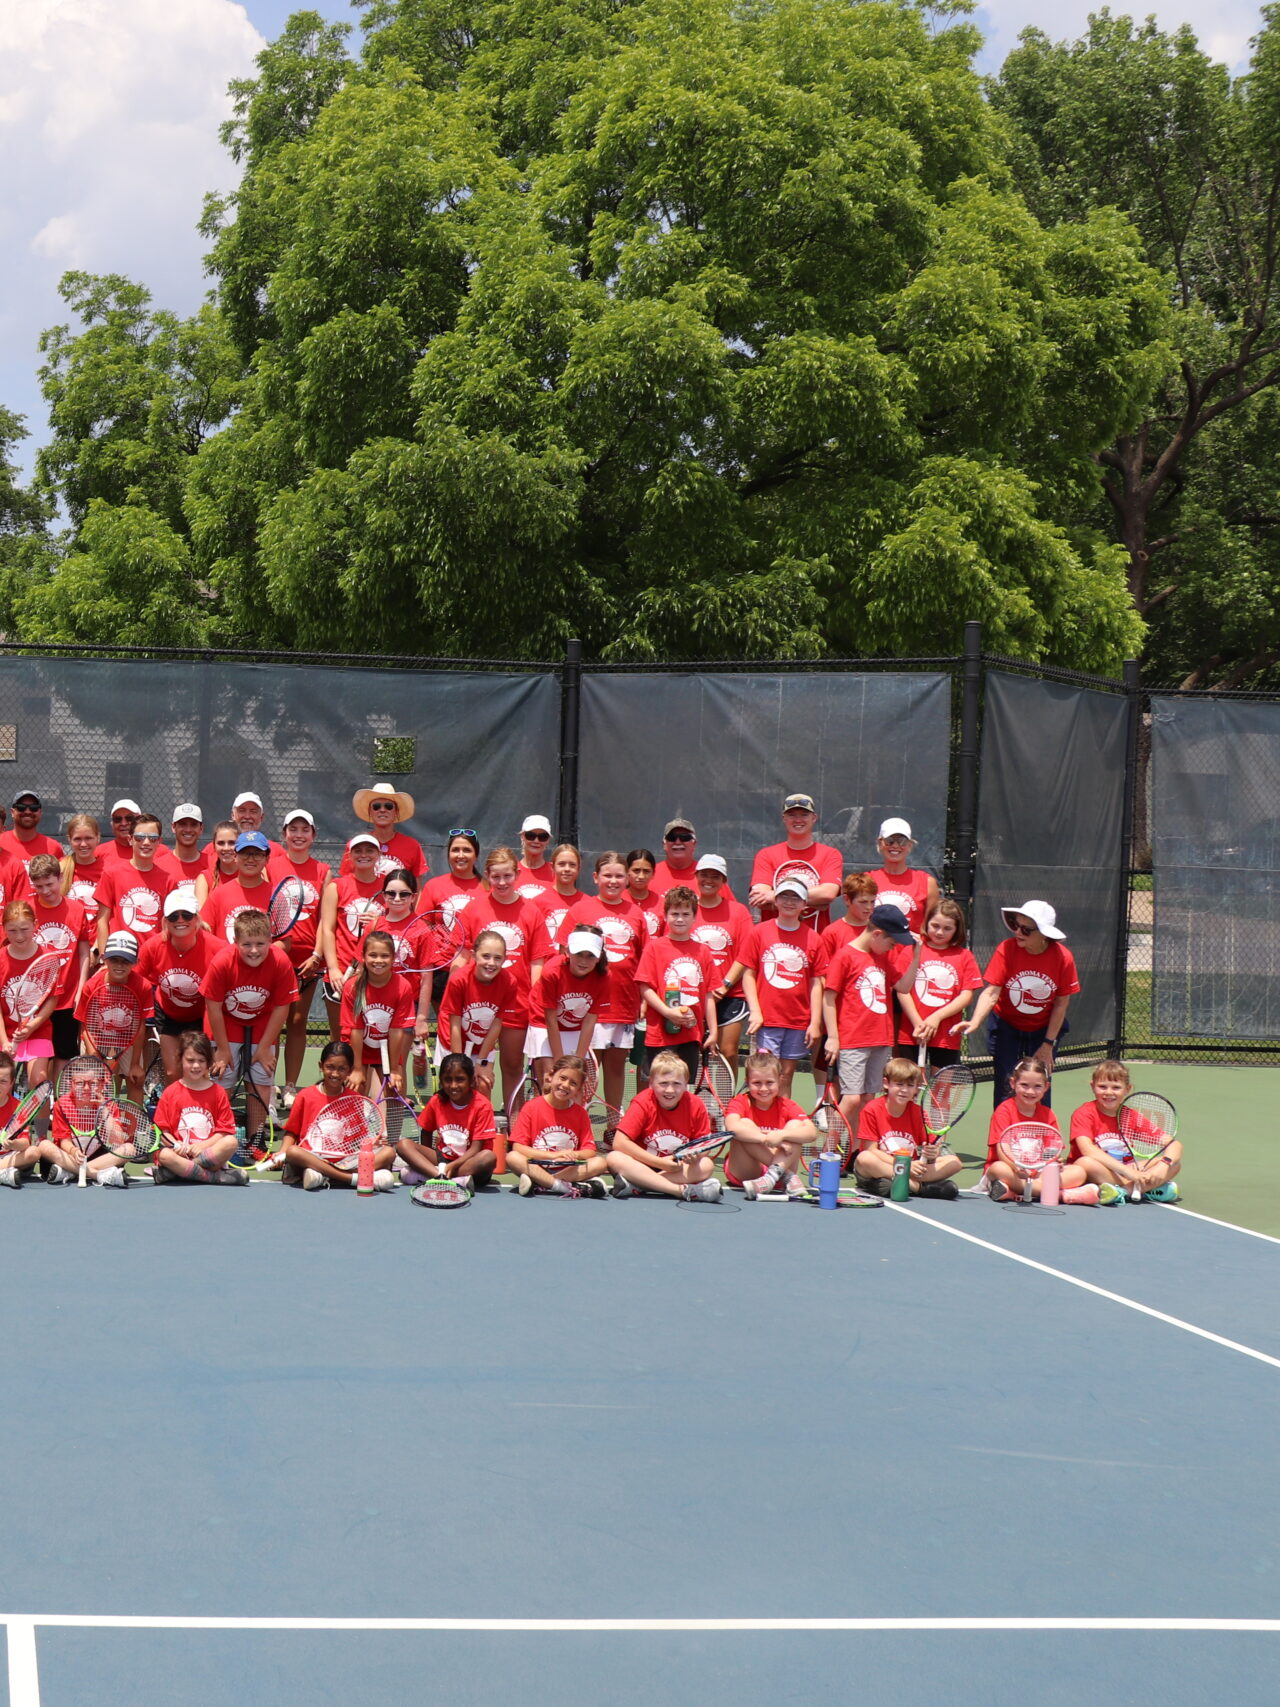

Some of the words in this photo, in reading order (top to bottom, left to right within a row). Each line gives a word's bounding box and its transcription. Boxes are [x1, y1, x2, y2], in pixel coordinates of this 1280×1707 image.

[761, 943, 793, 963] OKLAHOMA
[793, 944, 809, 968] TENNIS
[777, 971, 804, 979] FOUNDATION
[1006, 970, 1041, 990] OKLAHOMA
[1041, 972, 1058, 993] TENNIS
[893, 1163, 905, 1175] G
